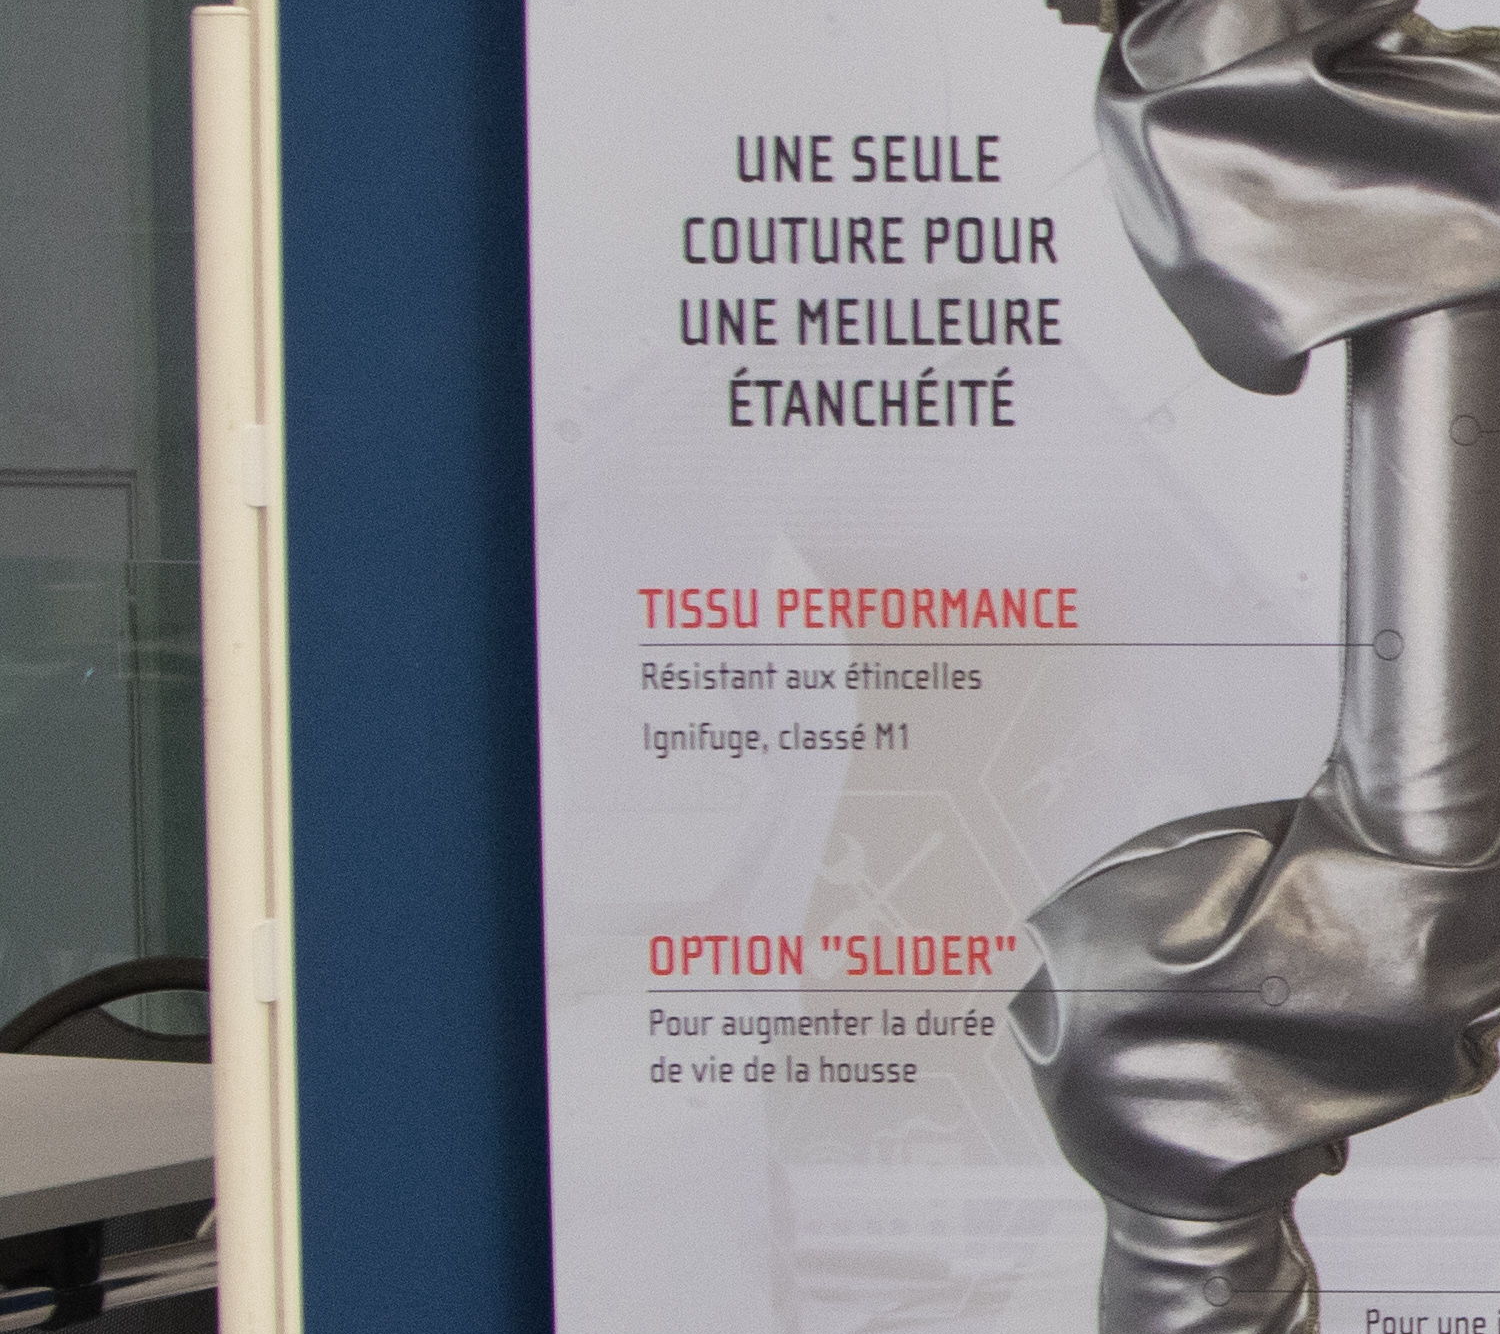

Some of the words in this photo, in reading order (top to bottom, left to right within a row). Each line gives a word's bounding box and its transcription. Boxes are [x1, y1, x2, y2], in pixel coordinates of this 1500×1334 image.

[737, 135, 834, 183] UNE
[852, 135, 1002, 183] SEULE
[683, 217, 906, 265] COUTURE
[925, 217, 1058, 265] POUR
[680, 298, 778, 346] UNE
[798, 298, 1063, 346] MEILLEURE
[729, 367, 1017, 428] ÉTANCHÉITÉ
[637, 588, 759, 629] TISSU
[777, 588, 1079, 629] PERFORMANCE
[641, 662, 777, 691] Résistant
[786, 669, 837, 691] aux
[845, 662, 983, 691] étincelles
[643, 722, 770, 759] Ignifuge,
[779, 722, 867, 752] classé
[875, 723, 910, 751] M1
[649, 935, 803, 976] OPTION
[821, 935, 1017, 976] "SLIDER"
[649, 1008, 714, 1037] Pour
[722, 1009, 873, 1044] augmenter
[882, 1009, 906, 1037] la
[916, 1008, 995, 1037] durée
[650, 1056, 683, 1083] de
[691, 1056, 733, 1083] vie
[742, 1056, 777, 1083] de
[787, 1056, 810, 1083] la
[819, 1056, 918, 1083] housse
